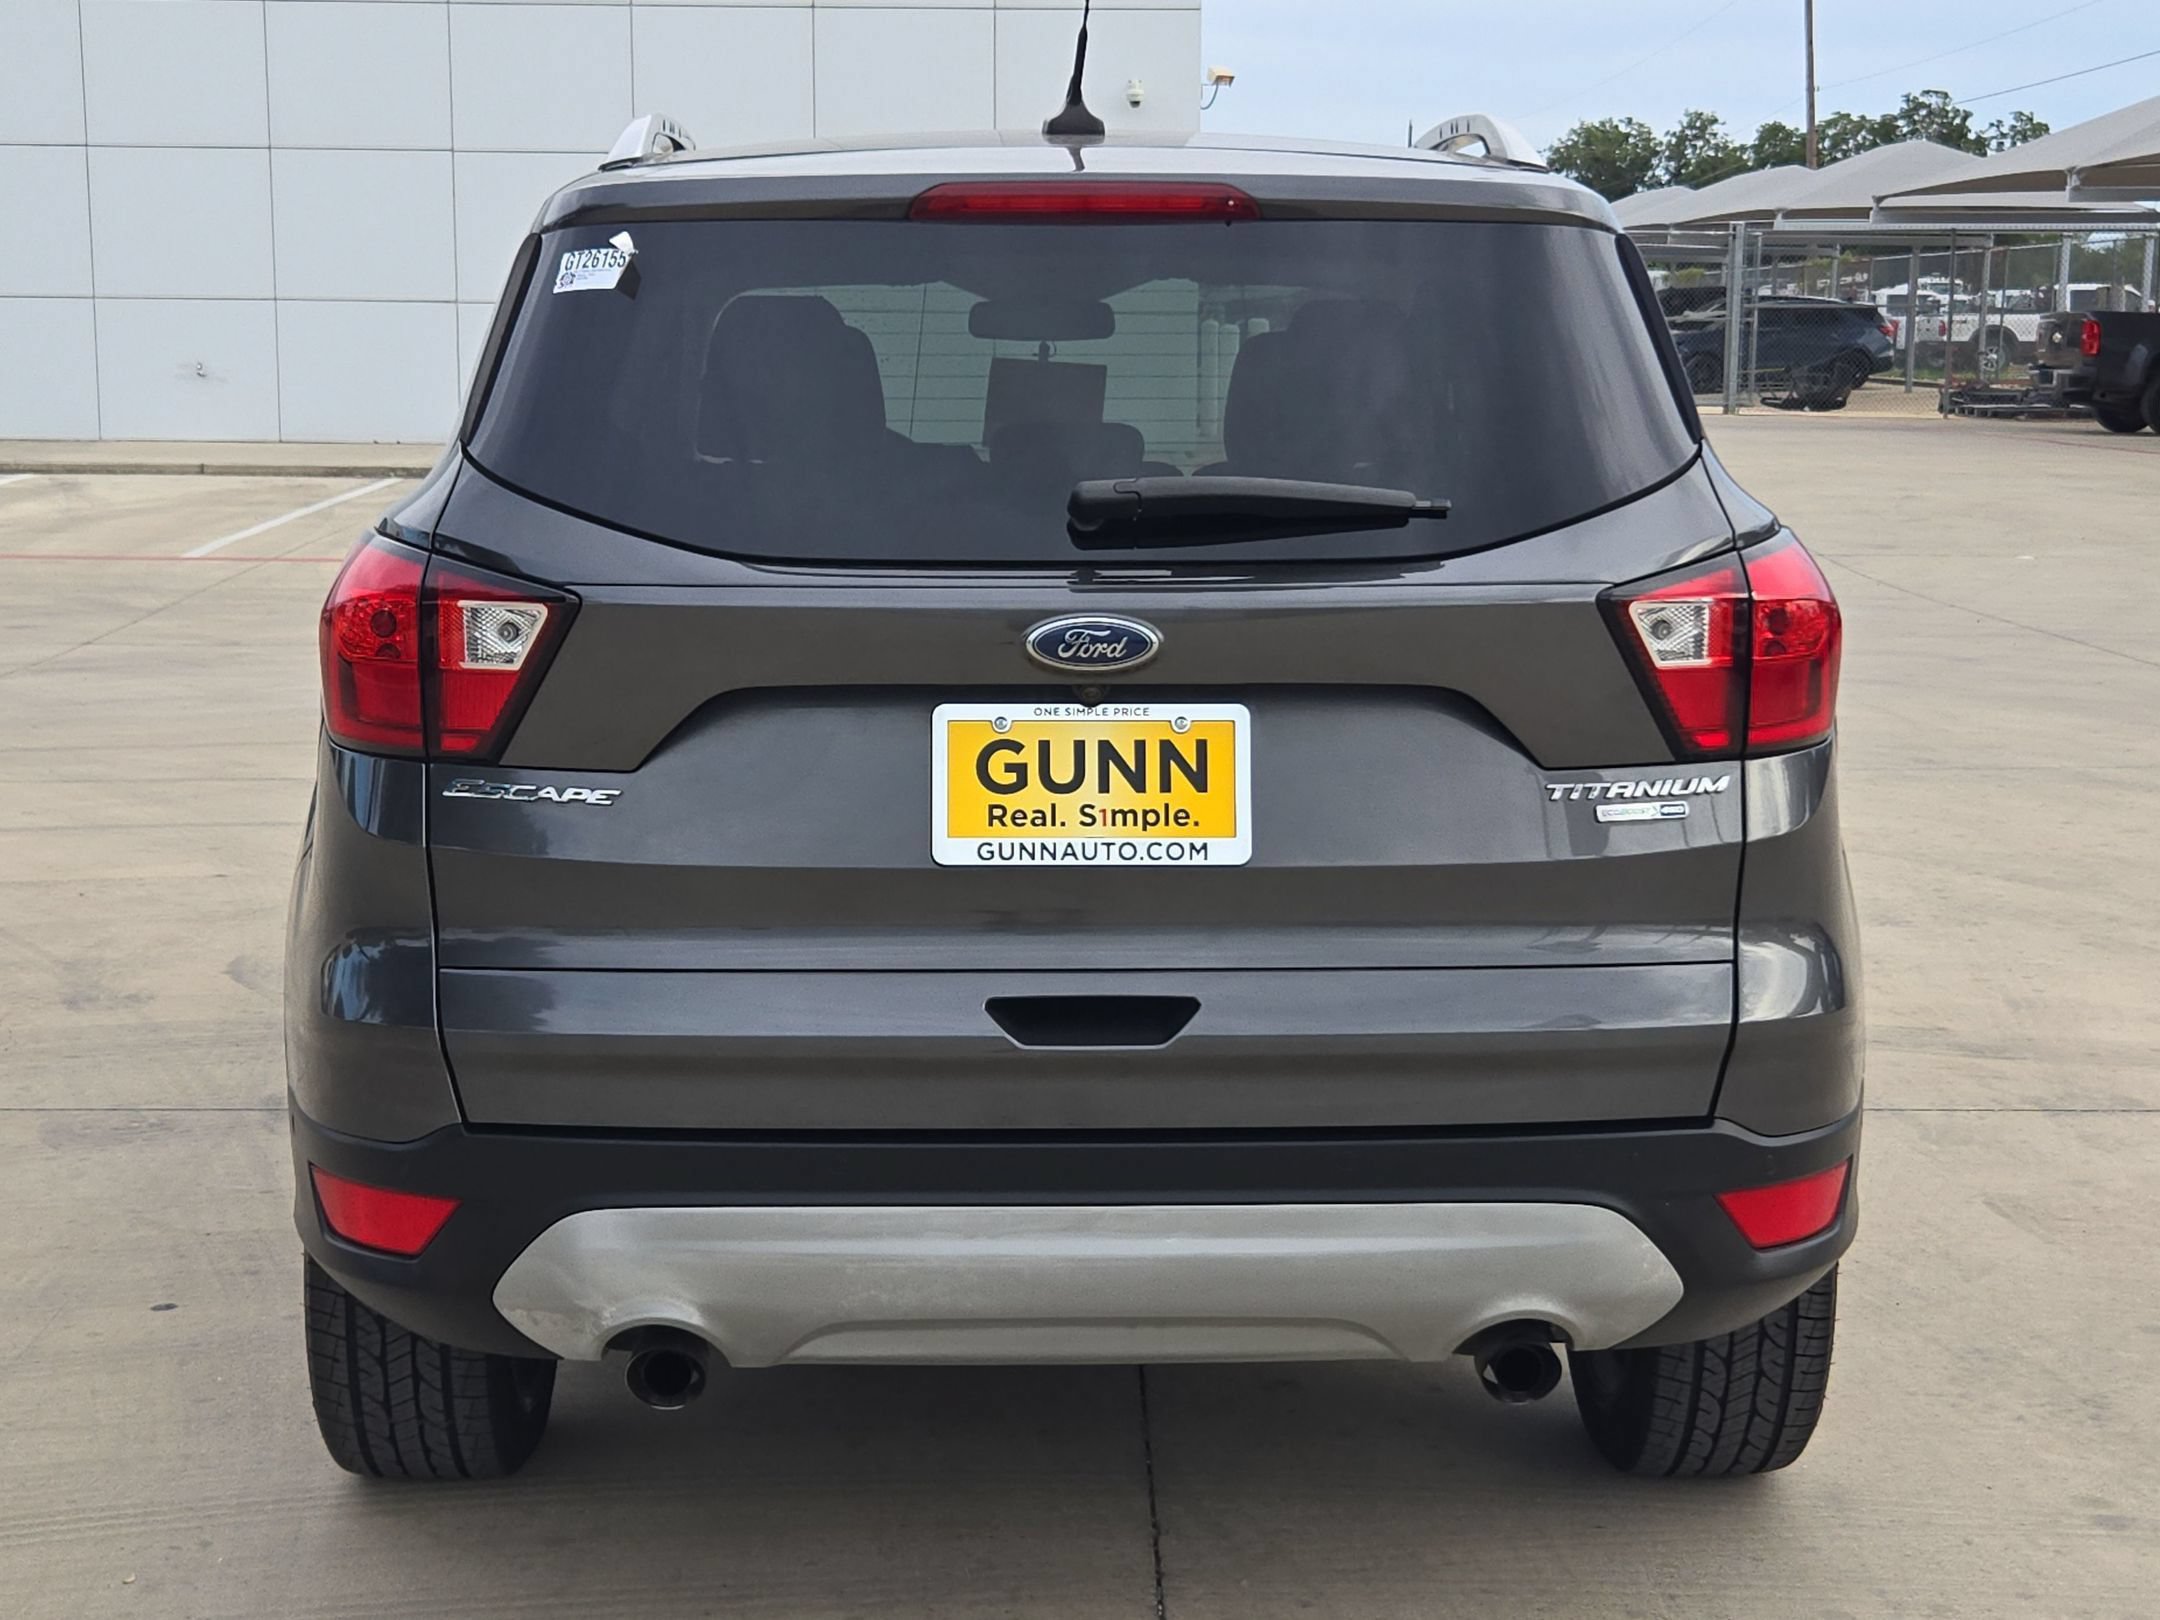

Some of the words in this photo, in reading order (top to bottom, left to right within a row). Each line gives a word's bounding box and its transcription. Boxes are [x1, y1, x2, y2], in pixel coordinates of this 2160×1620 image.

[564, 250, 627, 272] GT26155
[1057, 628, 1129, 659] Ford
[1033, 706, 1061, 717] ONE
[1064, 706, 1109, 717] SIMPLE
[1113, 706, 1150, 717] PRICE
[975, 738, 1209, 795] GUNN
[442, 778, 623, 806] ESCAPE
[1545, 775, 1732, 801] TITANIUM
[987, 803, 1067, 828] Real.
[976, 841, 1209, 862] GUNNAUTO.COM
